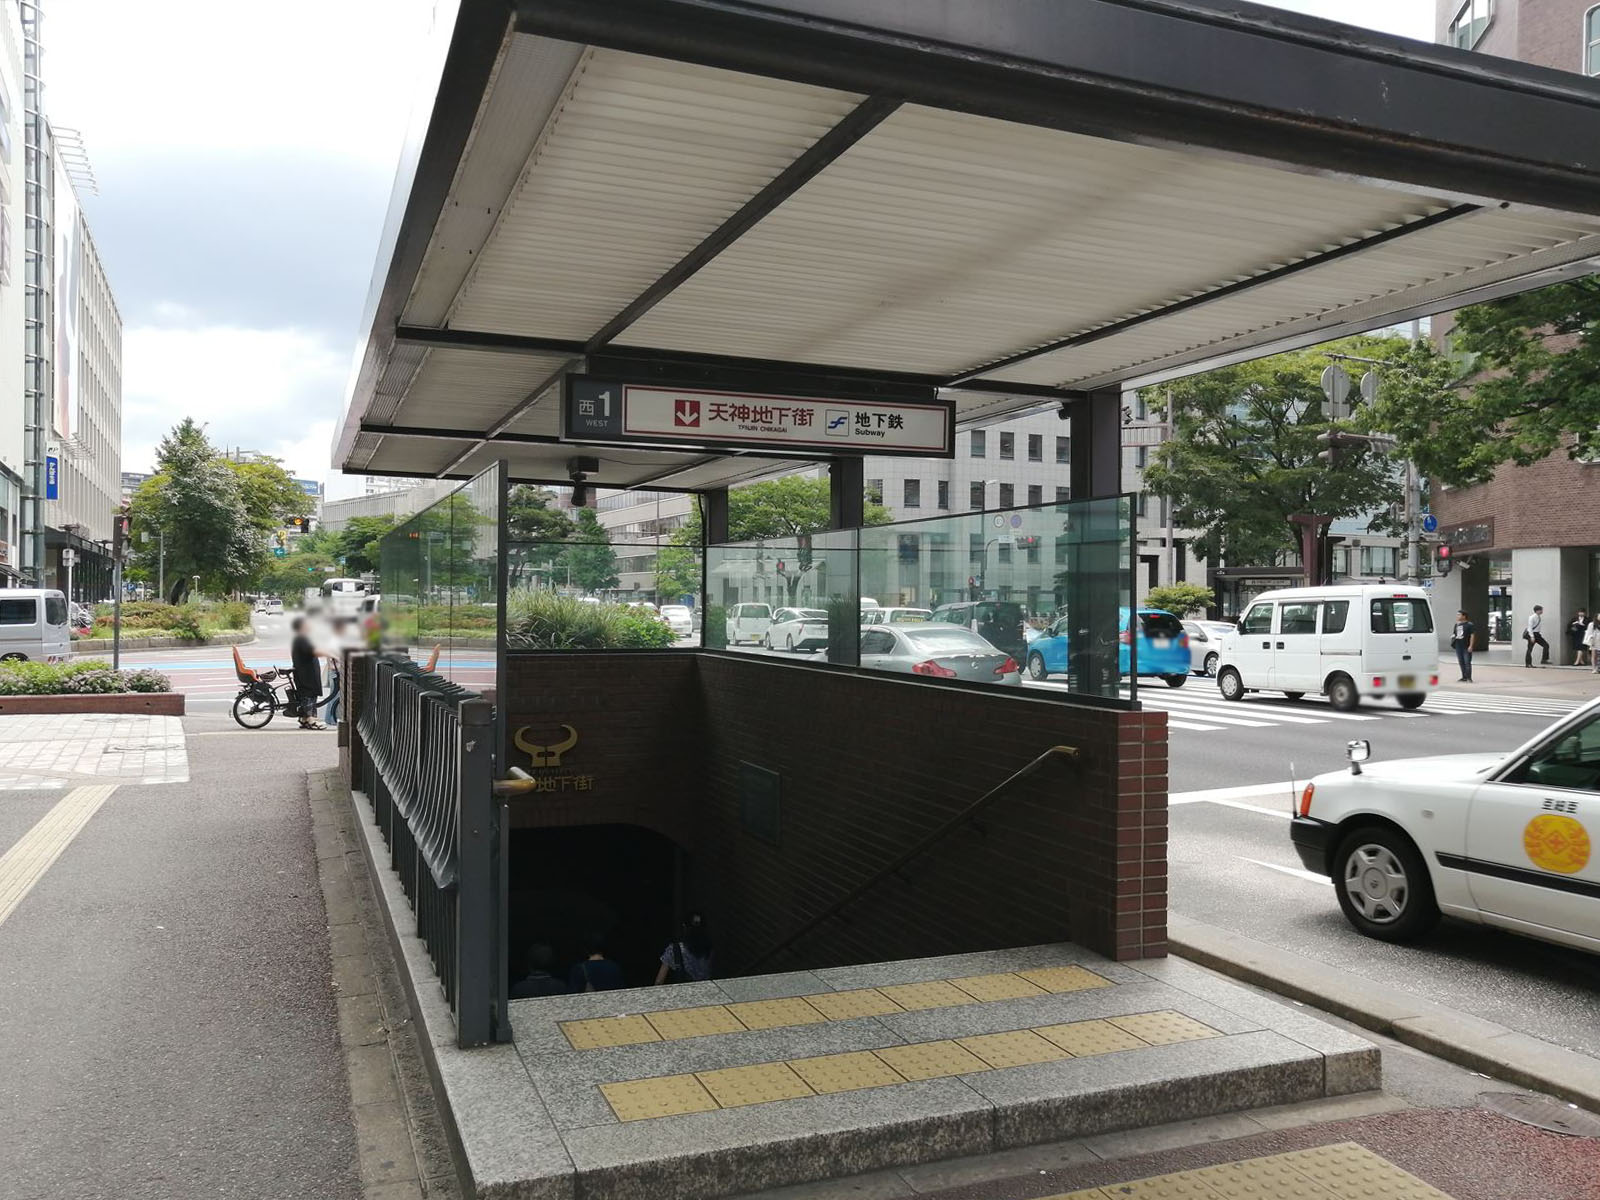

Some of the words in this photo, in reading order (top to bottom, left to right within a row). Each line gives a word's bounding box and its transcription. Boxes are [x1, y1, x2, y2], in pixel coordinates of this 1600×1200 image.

[579, 399, 595, 416] 西
[598, 391, 610, 417] 1
[585, 419, 609, 428] WEST
[708, 402, 815, 427] 天神地下街
[855, 411, 904, 430] 地下鉄
[855, 427, 886, 438] Subway
[535, 776, 595, 793] 地下街
